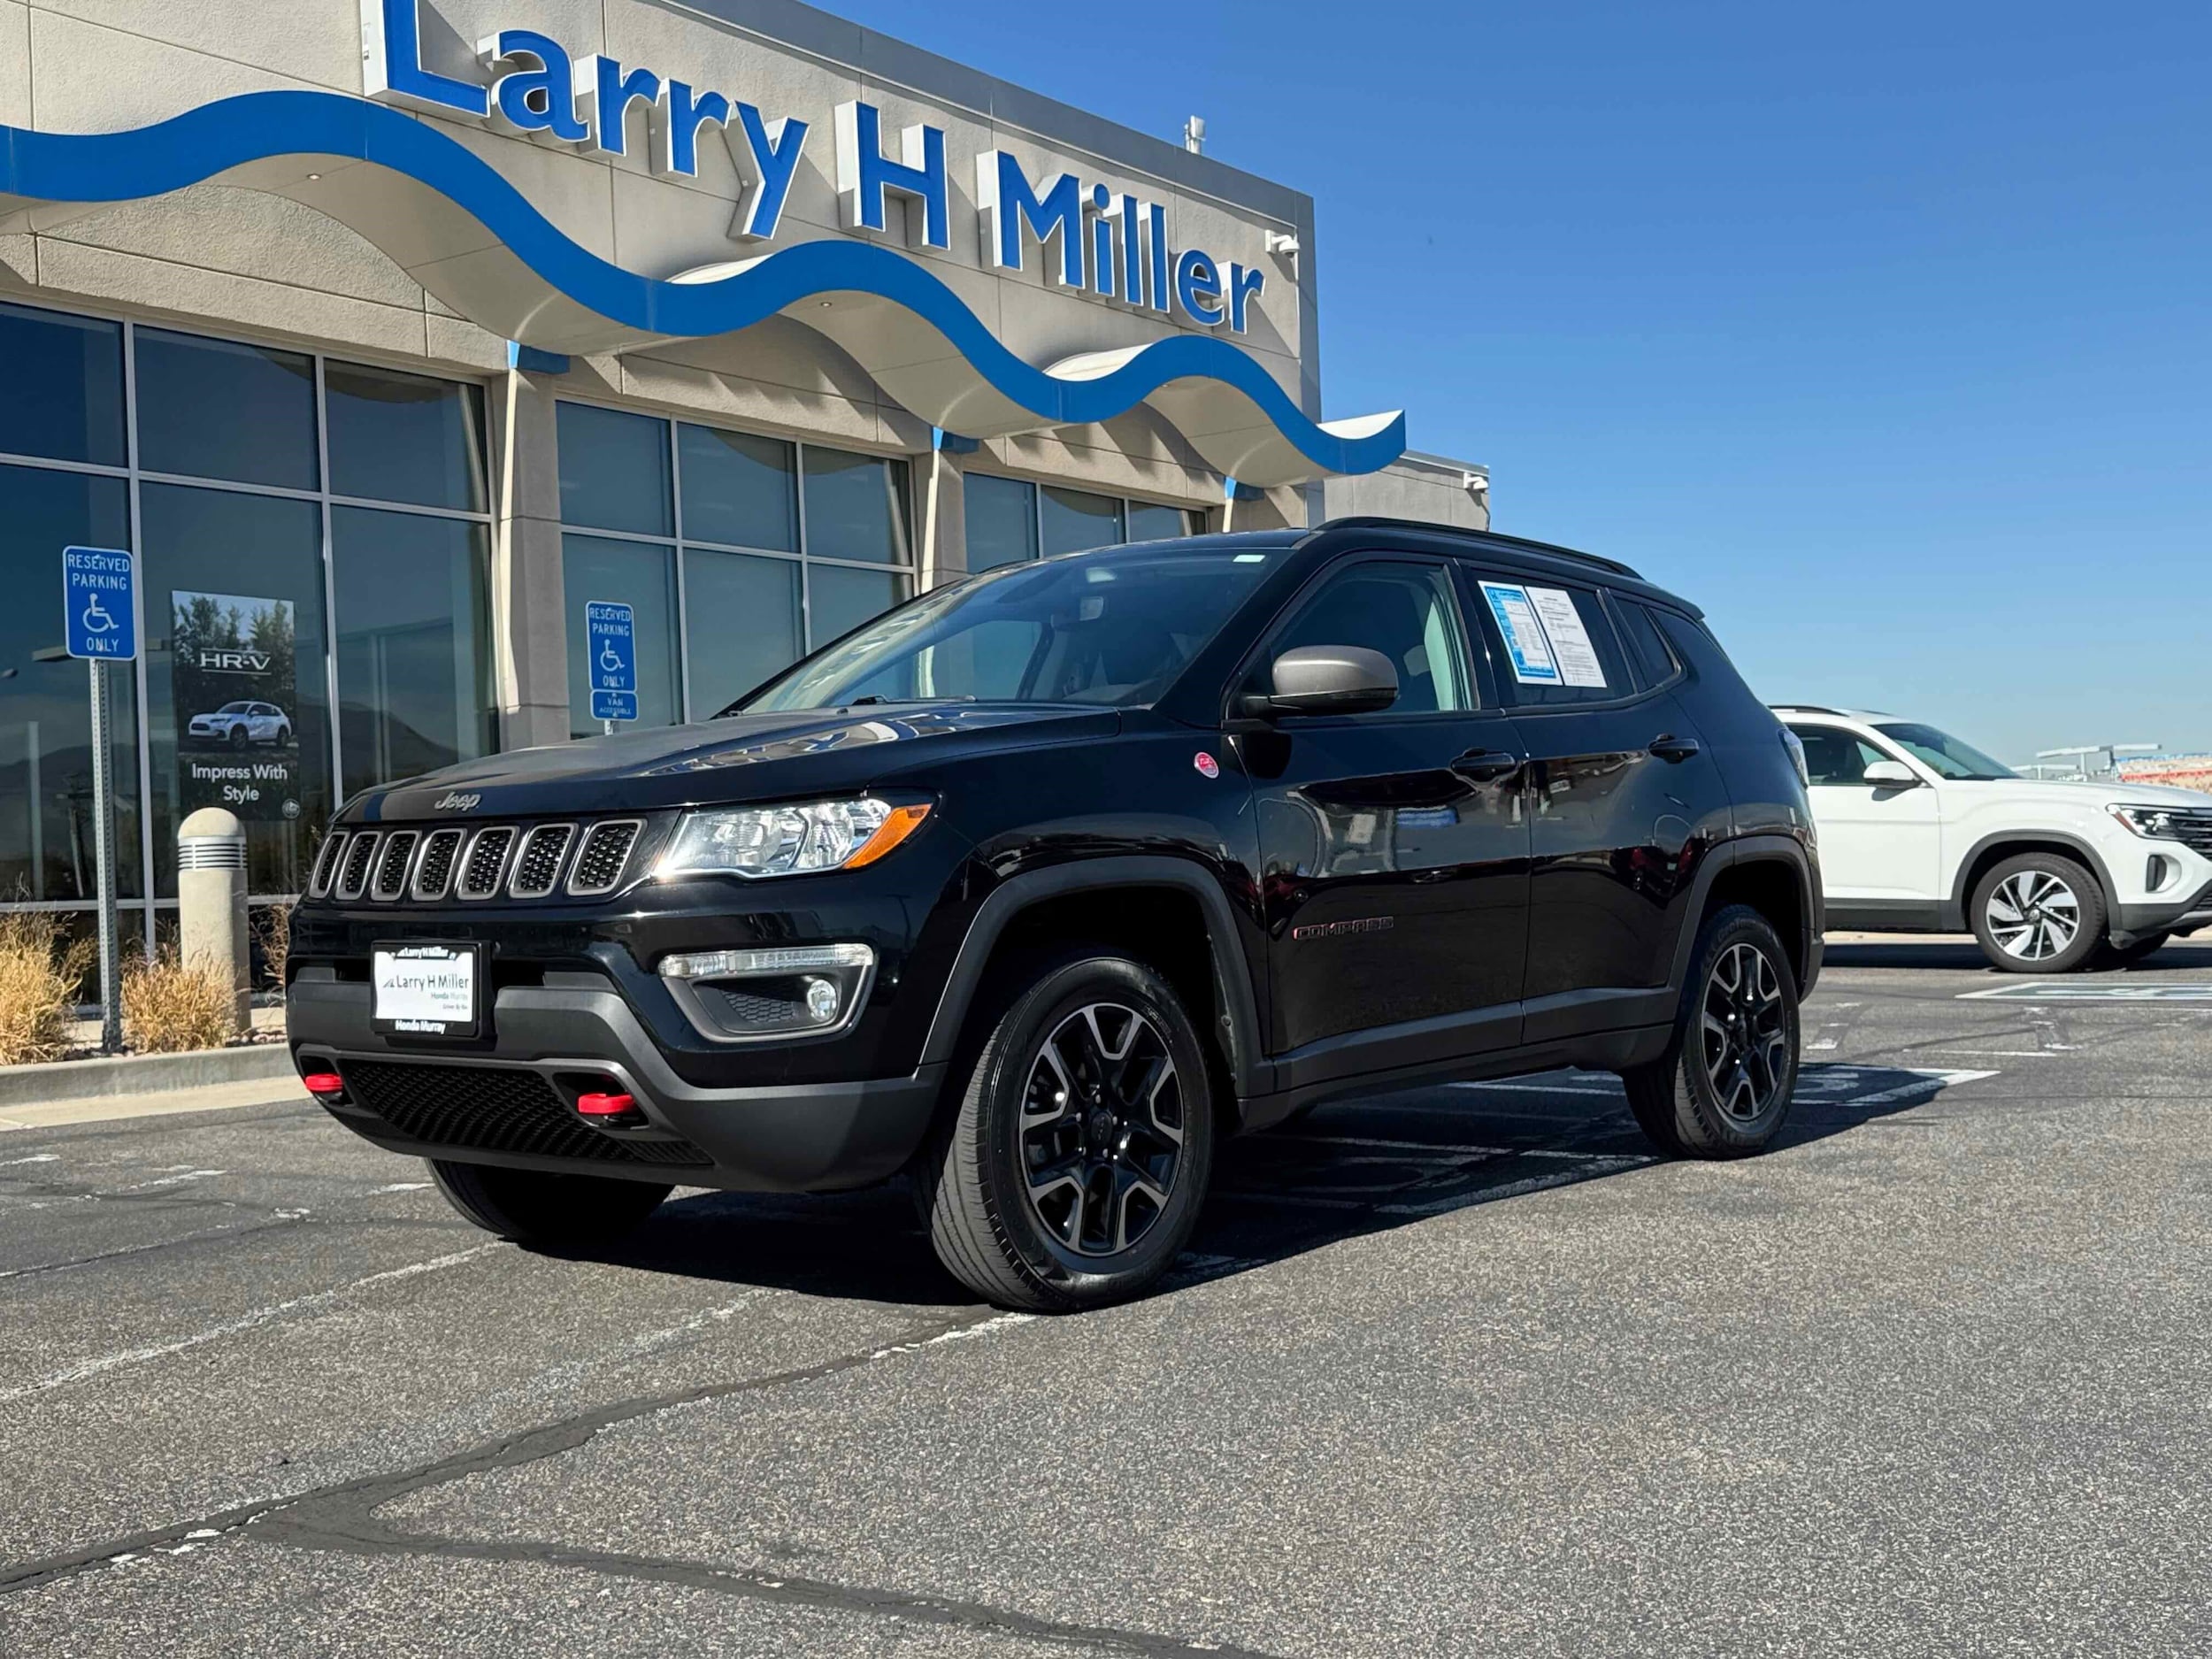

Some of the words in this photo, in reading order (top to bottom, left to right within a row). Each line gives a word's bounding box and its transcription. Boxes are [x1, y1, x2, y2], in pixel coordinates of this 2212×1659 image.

[380, 0, 810, 241] Larry
[855, 101, 952, 250] H
[993, 150, 1265, 334] Miller
[67, 554, 130, 572] RESERVED
[73, 572, 127, 591] PARKING
[589, 607, 631, 622] RESERVED
[592, 623, 630, 637] PARKING
[86, 637, 119, 652] ONLY
[200, 653, 271, 671] HR-V
[603, 674, 626, 687] ONLY
[607, 697, 624, 707] VAN
[192, 763, 250, 782] Impress
[253, 764, 288, 780] With
[223, 785, 260, 804] Style
[434, 792, 481, 811] Jeep
[1293, 916, 1394, 940] COMPASS
[396, 975, 425, 991] Larry
[427, 975, 435, 988] H
[438, 973, 469, 989] Miller
[395, 1019, 419, 1031] Honda
